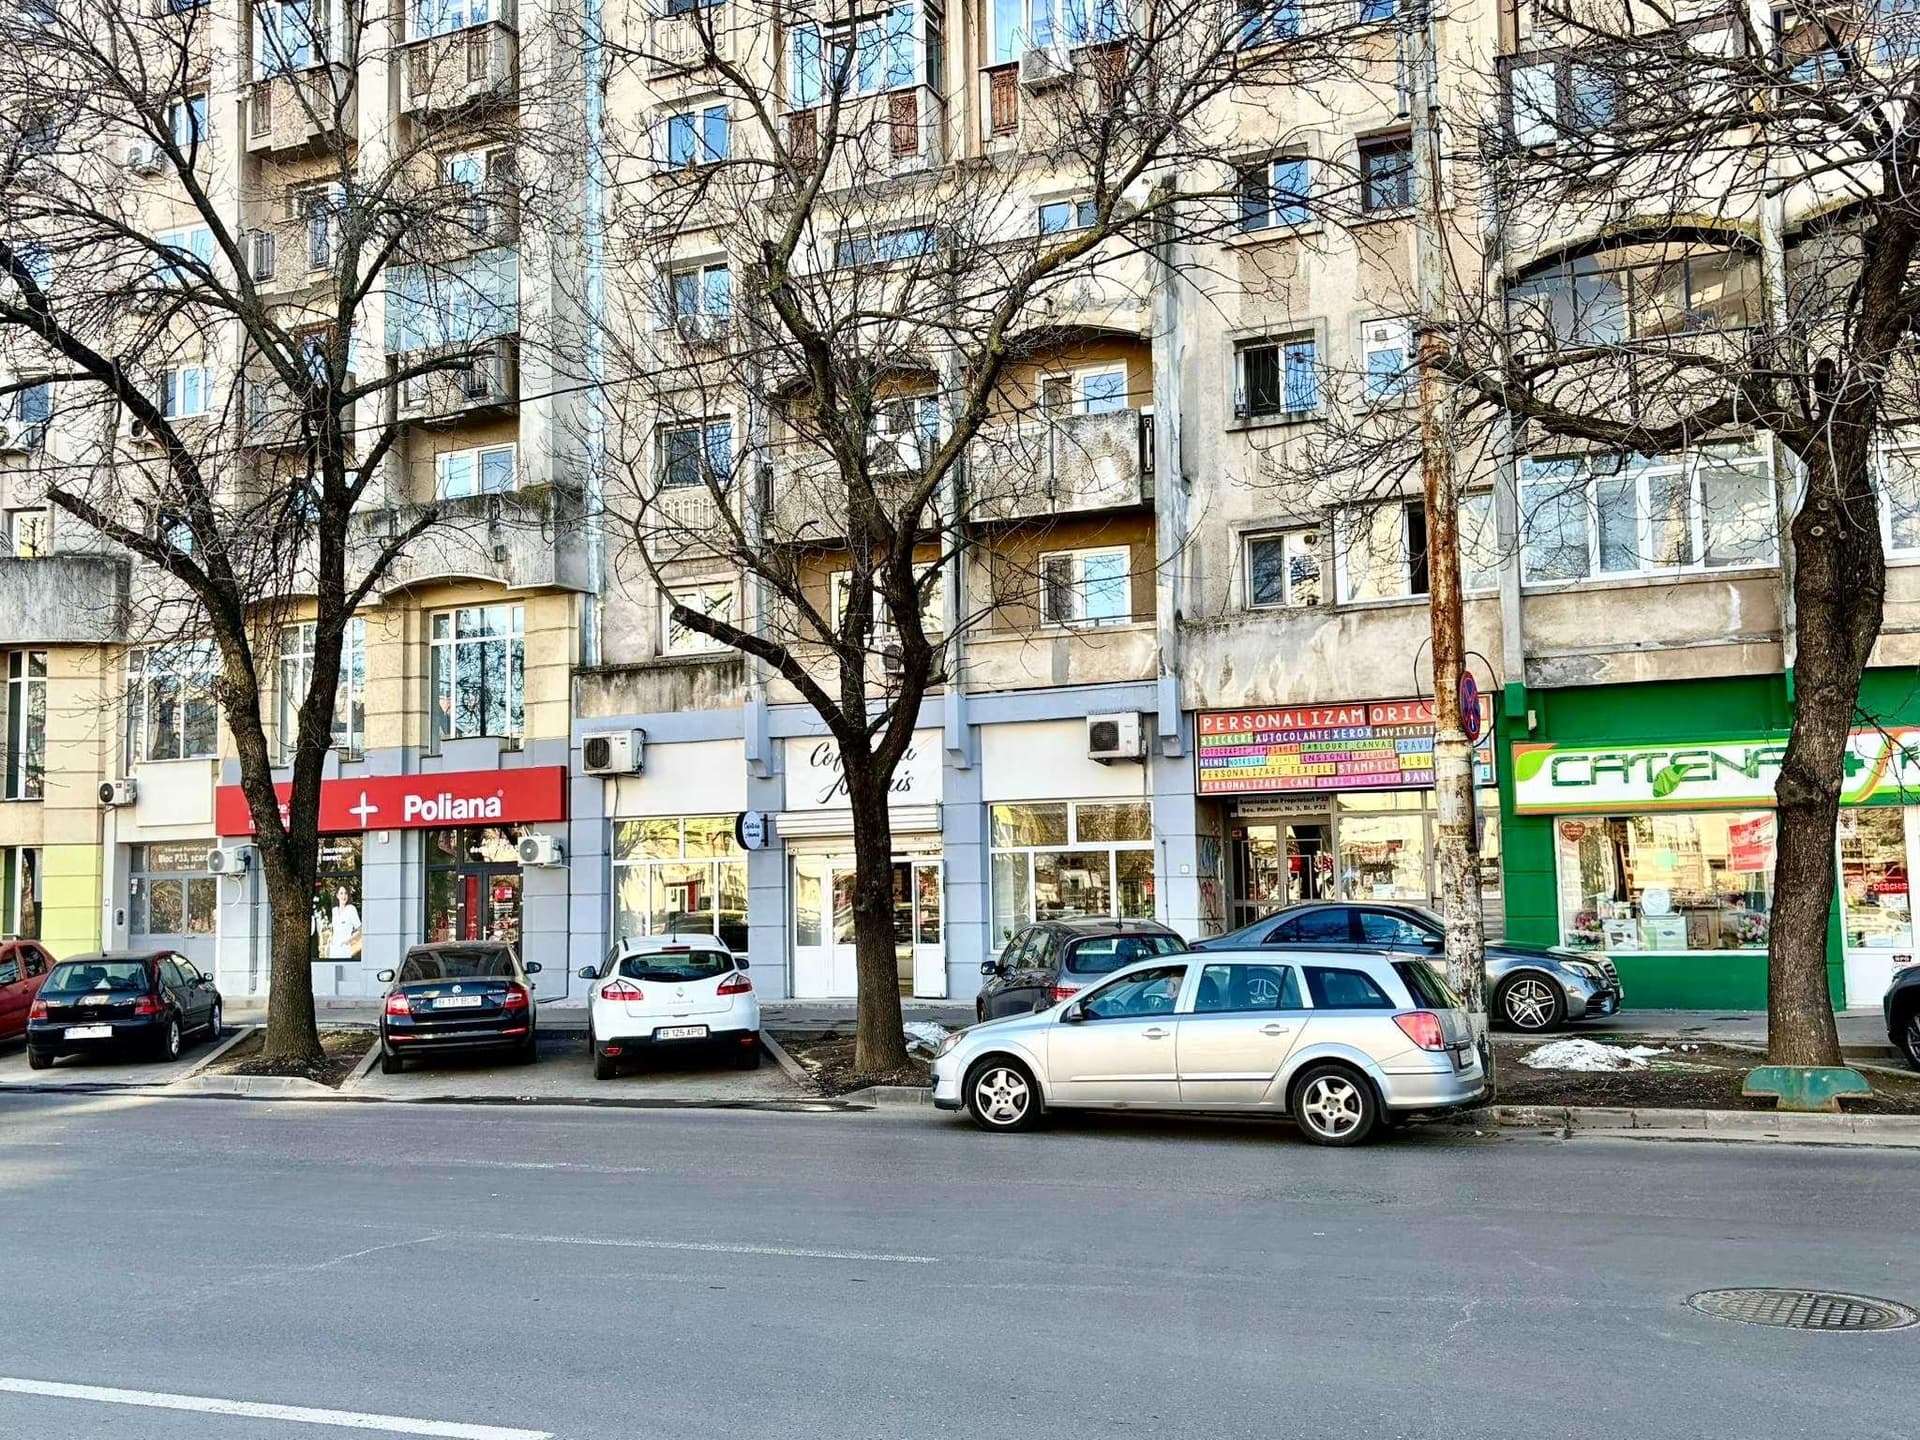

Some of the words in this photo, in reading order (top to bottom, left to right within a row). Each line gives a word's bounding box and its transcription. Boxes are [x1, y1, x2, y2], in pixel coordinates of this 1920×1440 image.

[1202, 709, 1364, 731] PERSONALIZAM
[1255, 731, 1330, 743] AUTOCOLANTE
[1333, 728, 1373, 739] XEROX
[1338, 758, 1398, 774] STAMPILE
[1551, 747, 1785, 787] CATENA
[1404, 771, 1434, 783] BAN
[404, 793, 501, 822] Poliana
